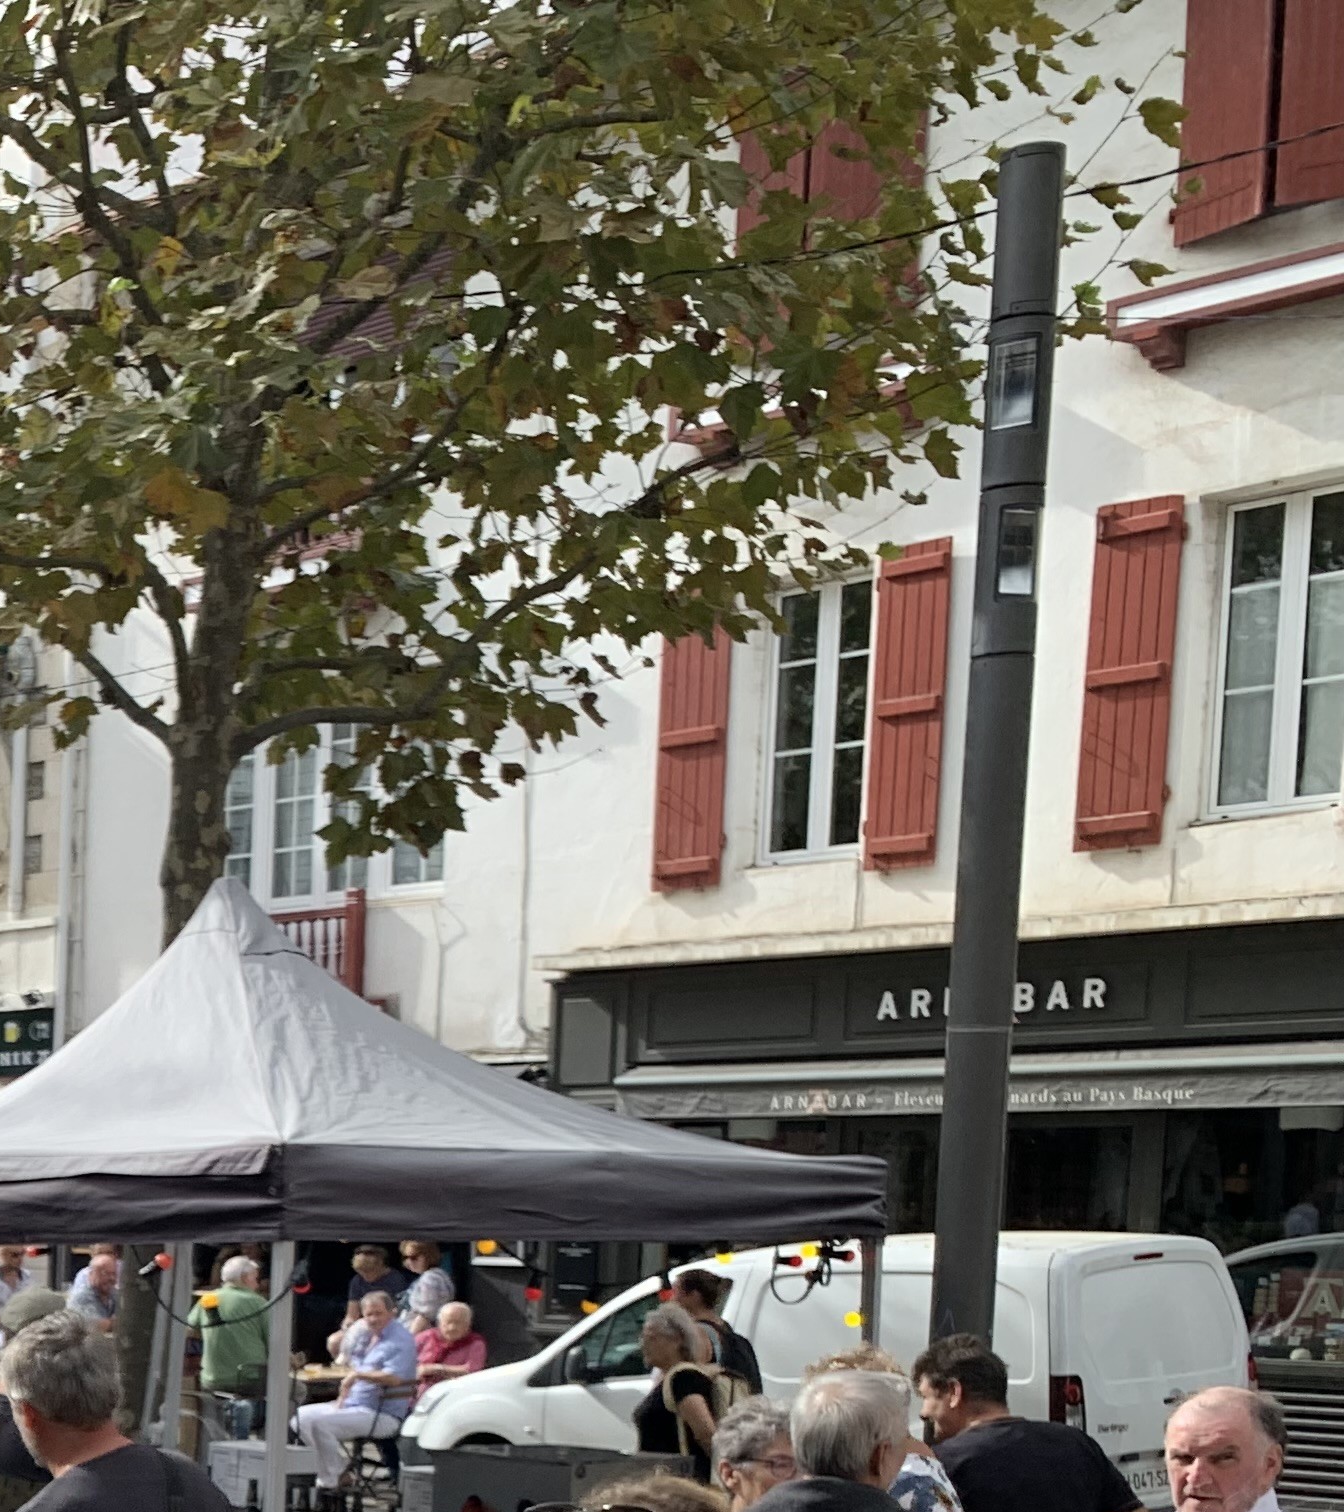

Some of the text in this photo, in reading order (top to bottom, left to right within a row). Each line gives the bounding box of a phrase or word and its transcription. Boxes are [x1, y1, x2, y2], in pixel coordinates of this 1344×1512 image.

[1063, 1090, 1082, 1102] au
[1090, 1087, 1125, 1106] Pays
[1133, 1086, 1194, 1104] Basque
